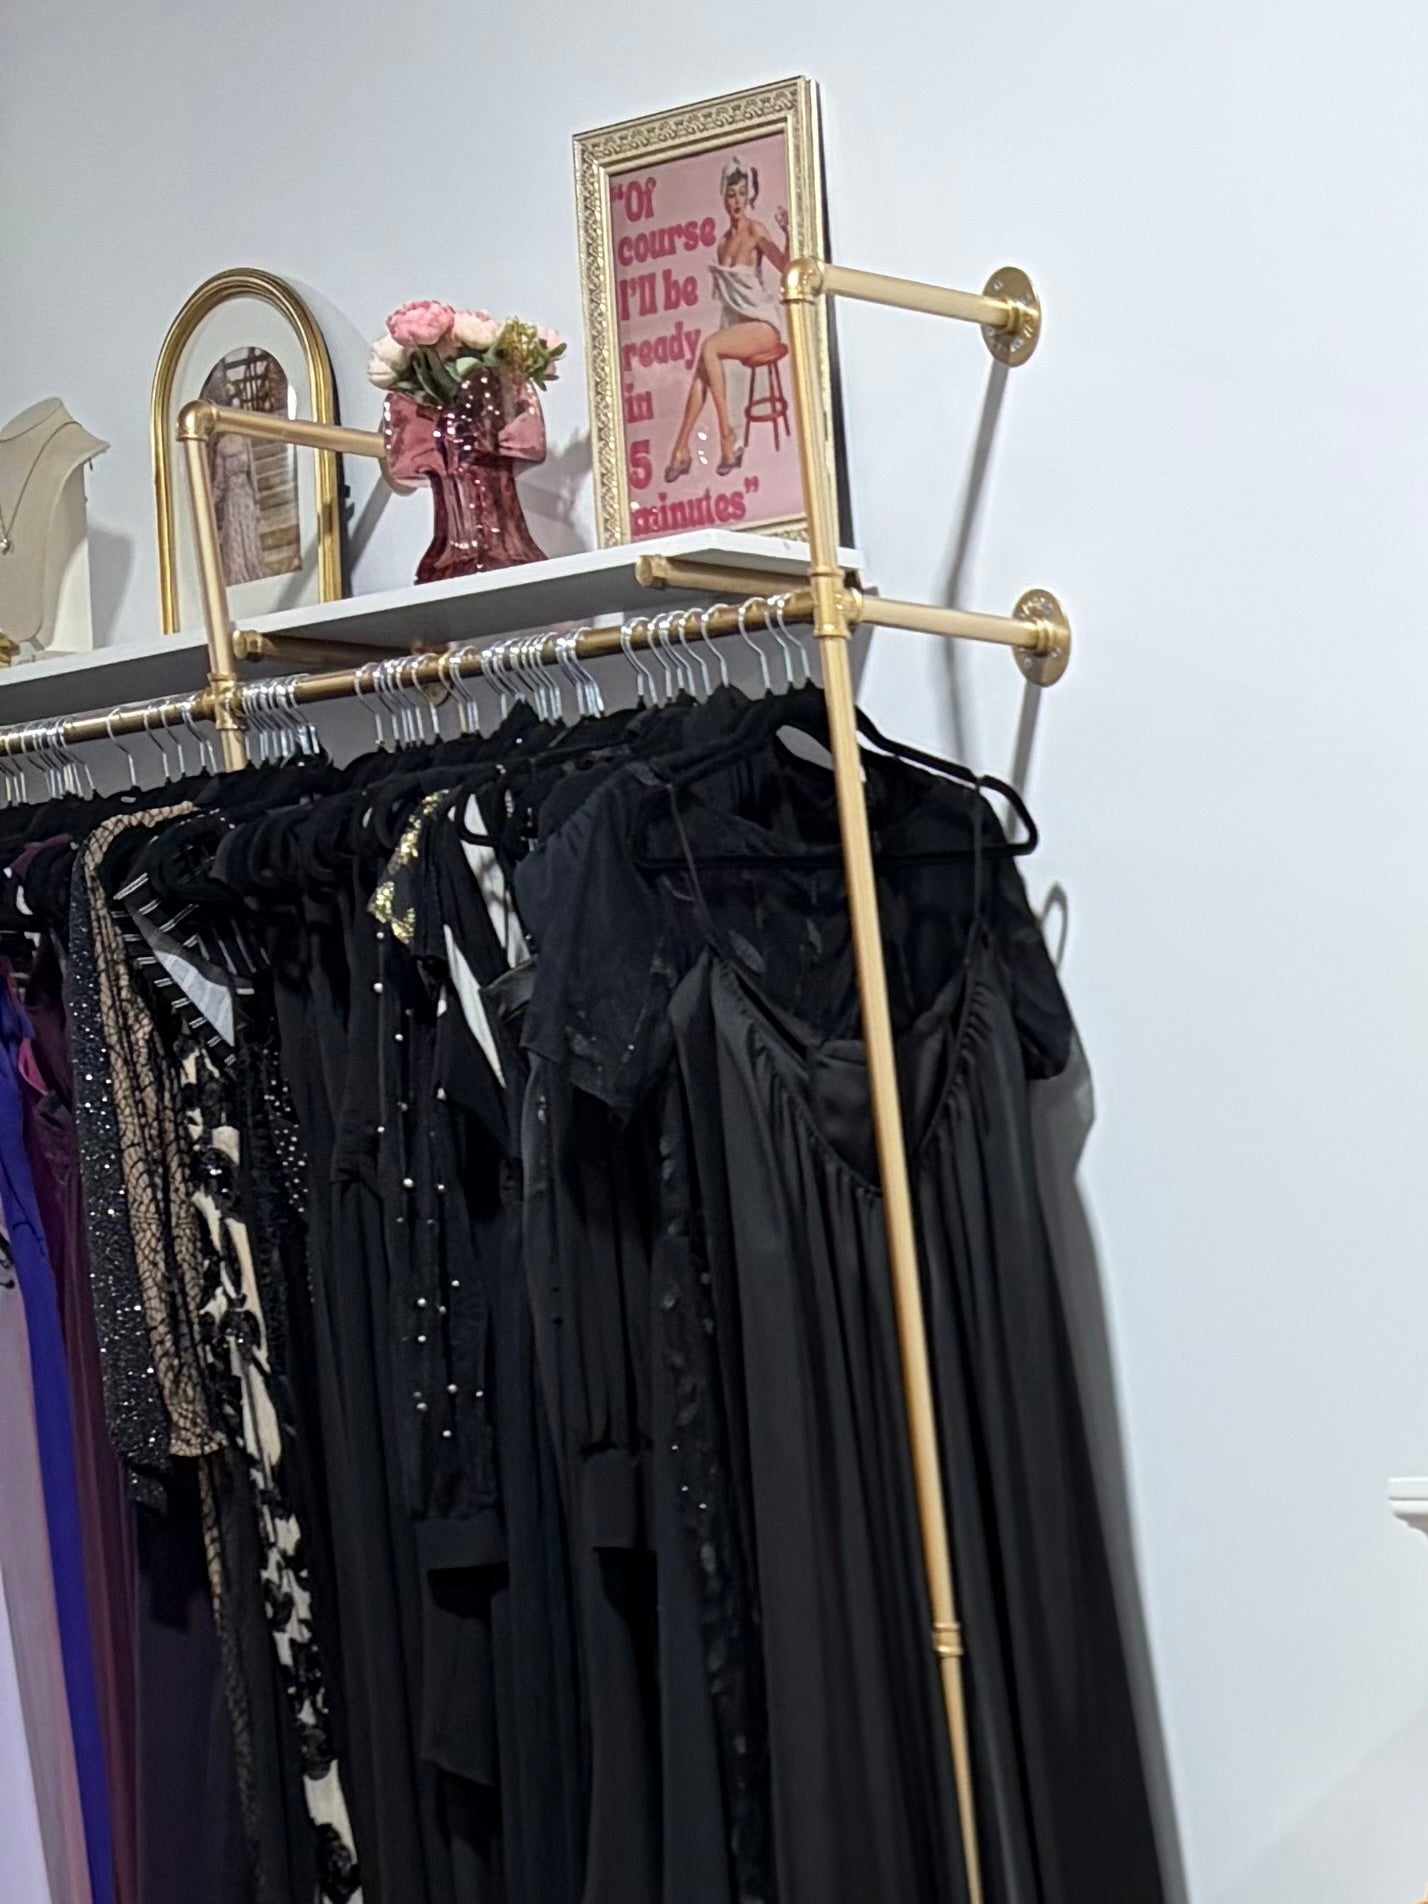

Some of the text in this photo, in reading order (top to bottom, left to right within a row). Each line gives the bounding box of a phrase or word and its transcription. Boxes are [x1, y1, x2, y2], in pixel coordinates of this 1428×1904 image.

[617, 217, 716, 266] course
[619, 268, 698, 321] I'll be
[621, 321, 701, 371] ready
[624, 383, 654, 424] in
[629, 439, 653, 490] 5
[630, 475, 759, 537] minutes"
